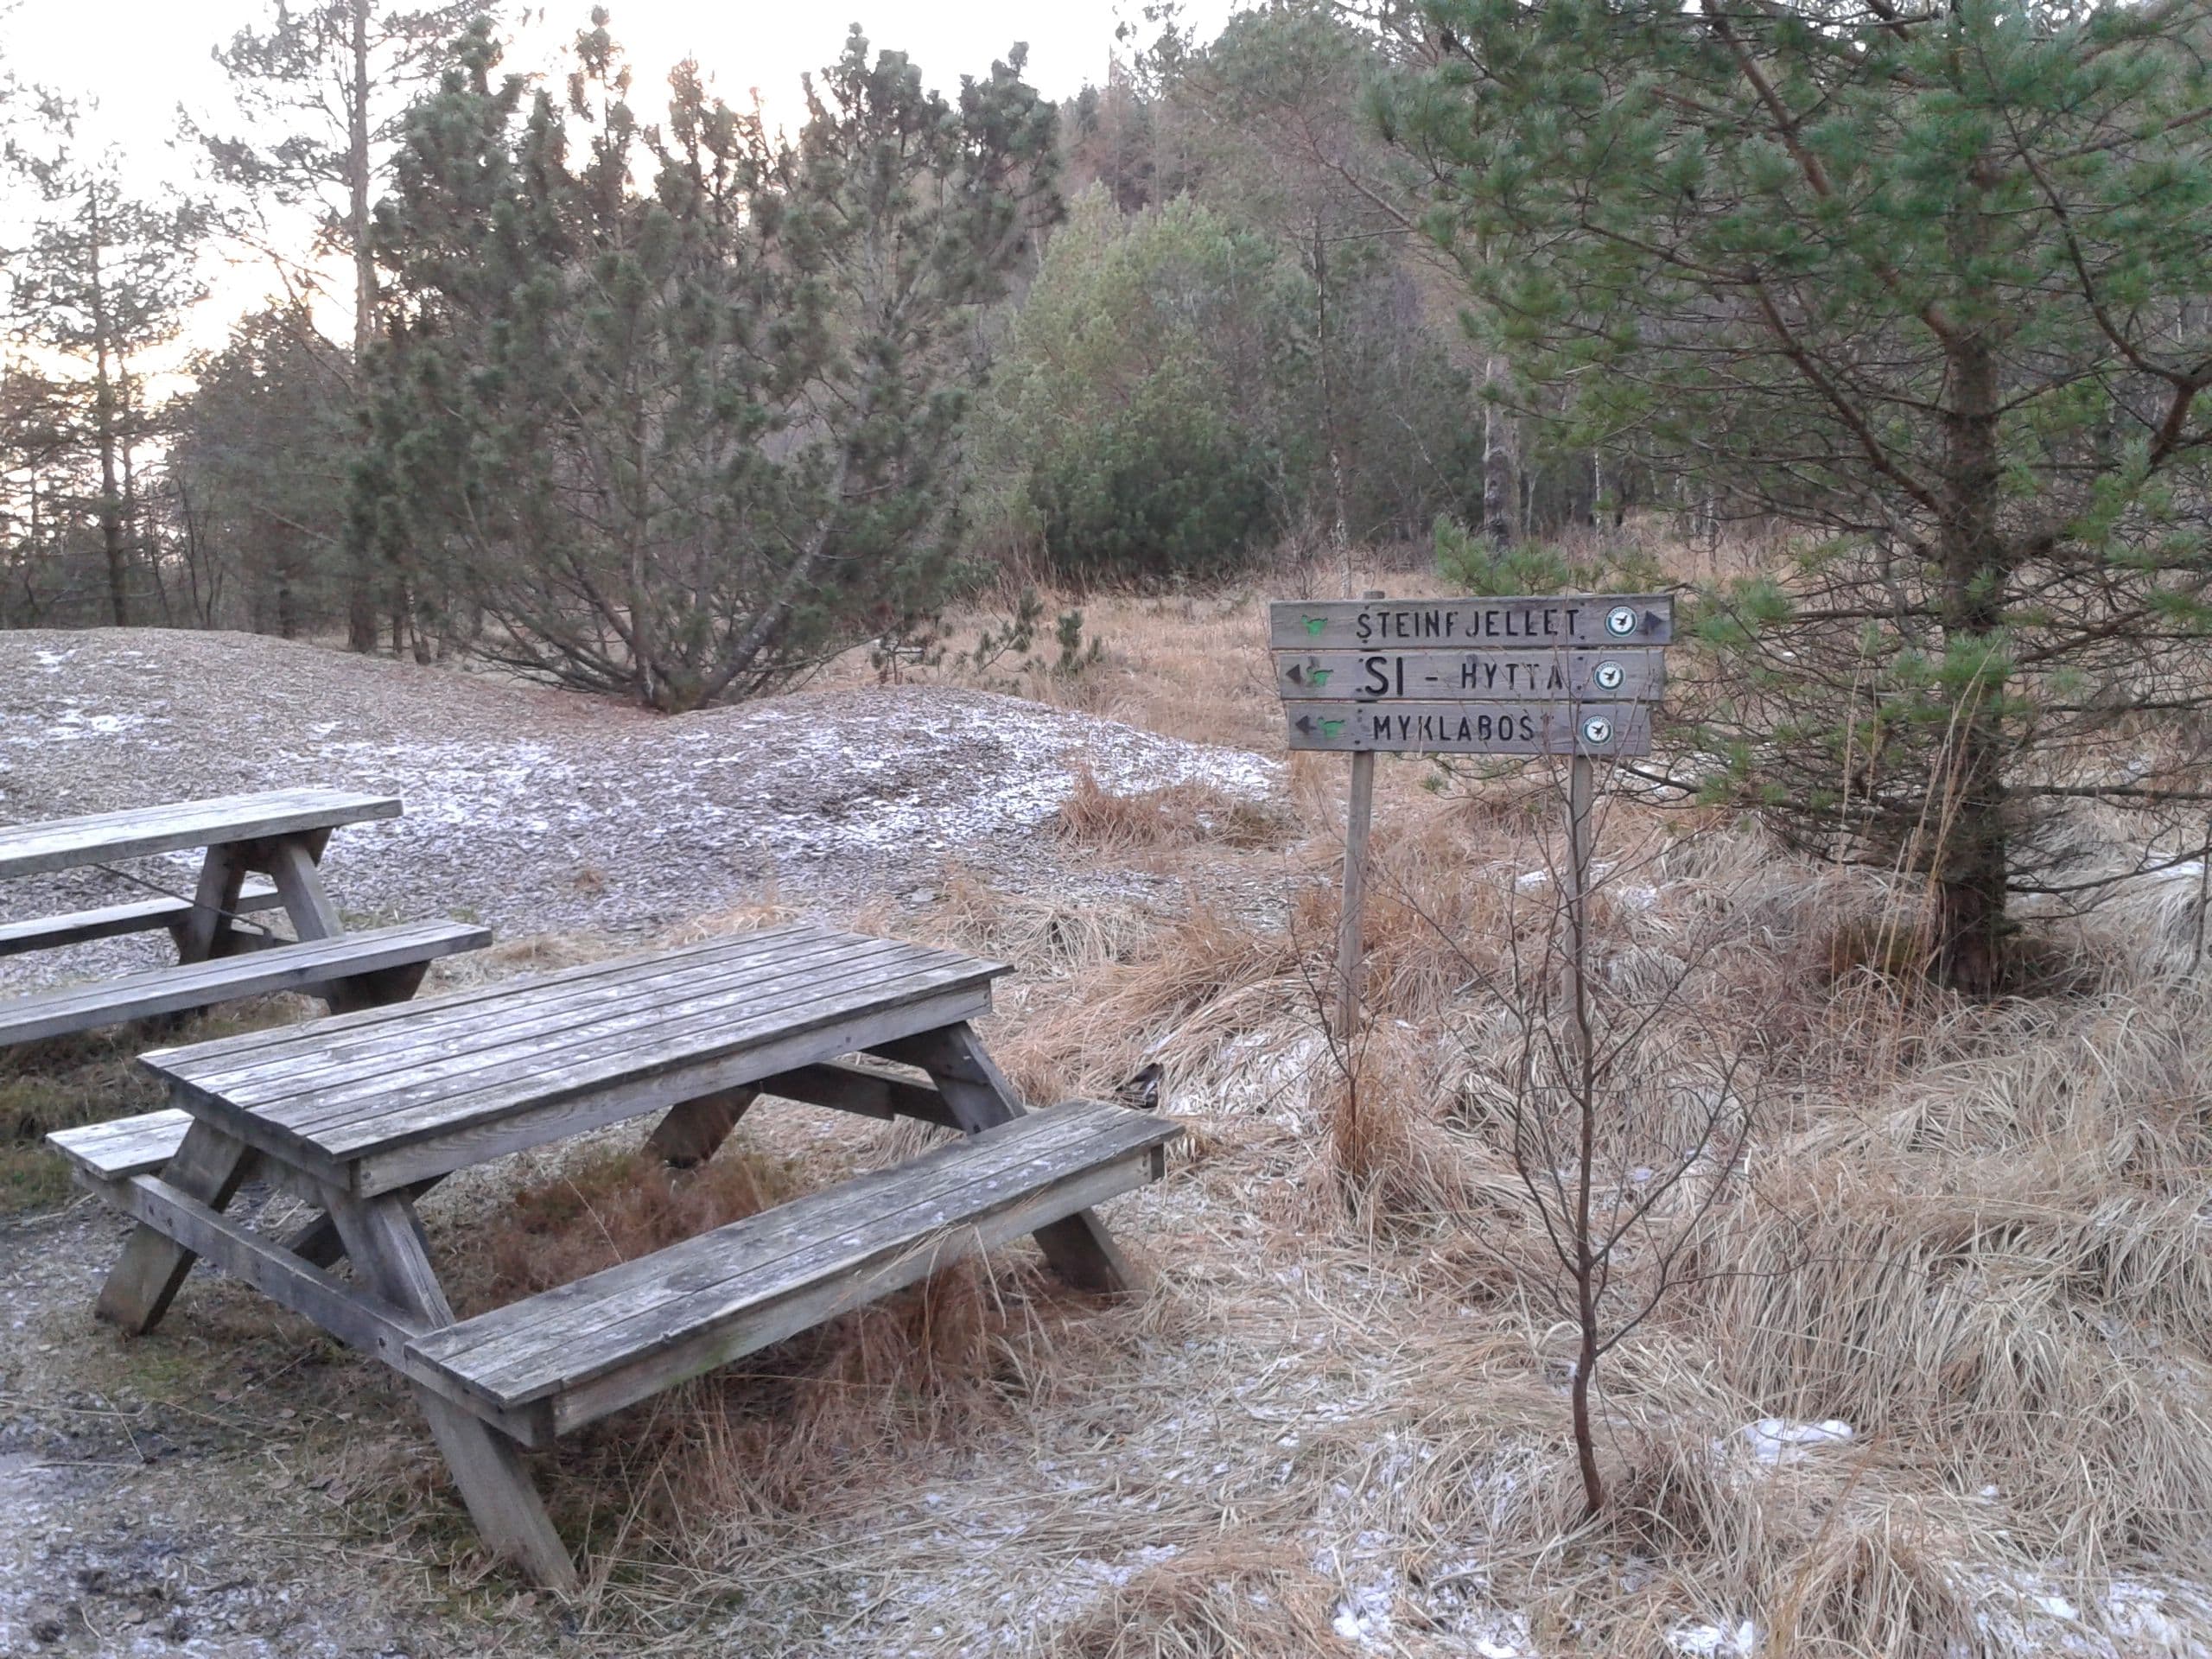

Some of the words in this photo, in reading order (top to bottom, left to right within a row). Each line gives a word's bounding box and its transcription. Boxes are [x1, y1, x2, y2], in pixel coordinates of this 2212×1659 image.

[1364, 656, 1404, 696] SI
[1461, 663, 1563, 690] HYTTA
[1373, 715, 1554, 741] MYKLABOS
